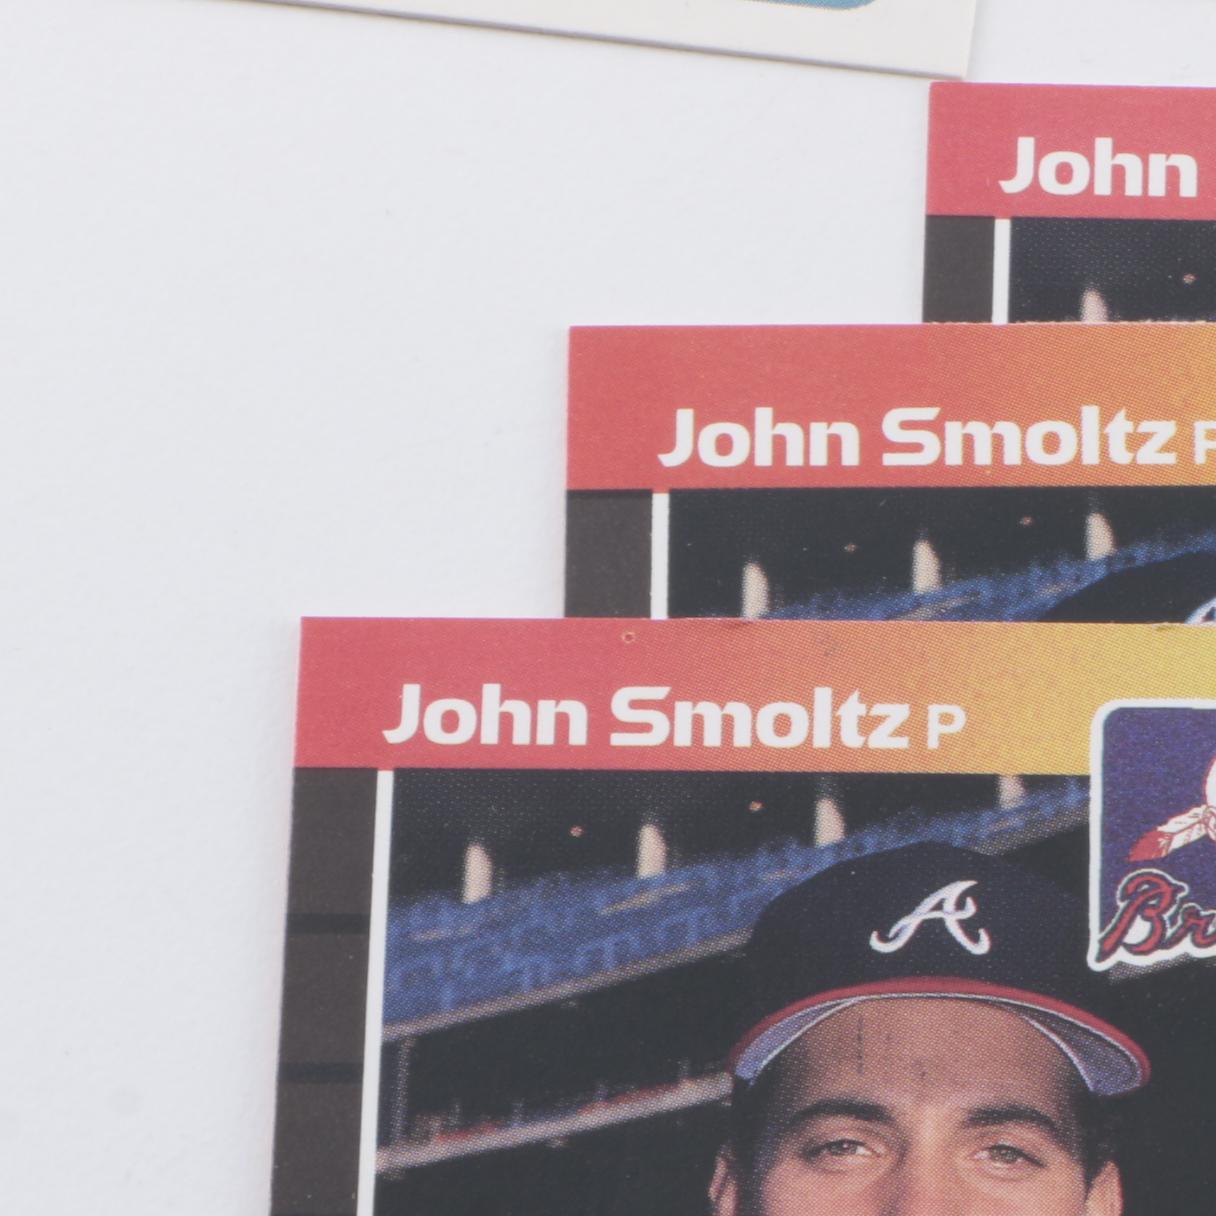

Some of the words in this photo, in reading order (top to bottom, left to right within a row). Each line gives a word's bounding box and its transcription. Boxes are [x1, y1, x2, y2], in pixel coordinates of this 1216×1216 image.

[998, 136, 1198, 198] John
[658, 407, 860, 468] John
[881, 405, 1178, 467] Smoltz
[383, 683, 589, 747] John
[609, 686, 910, 750] Smoltz
[927, 702, 968, 750] P
